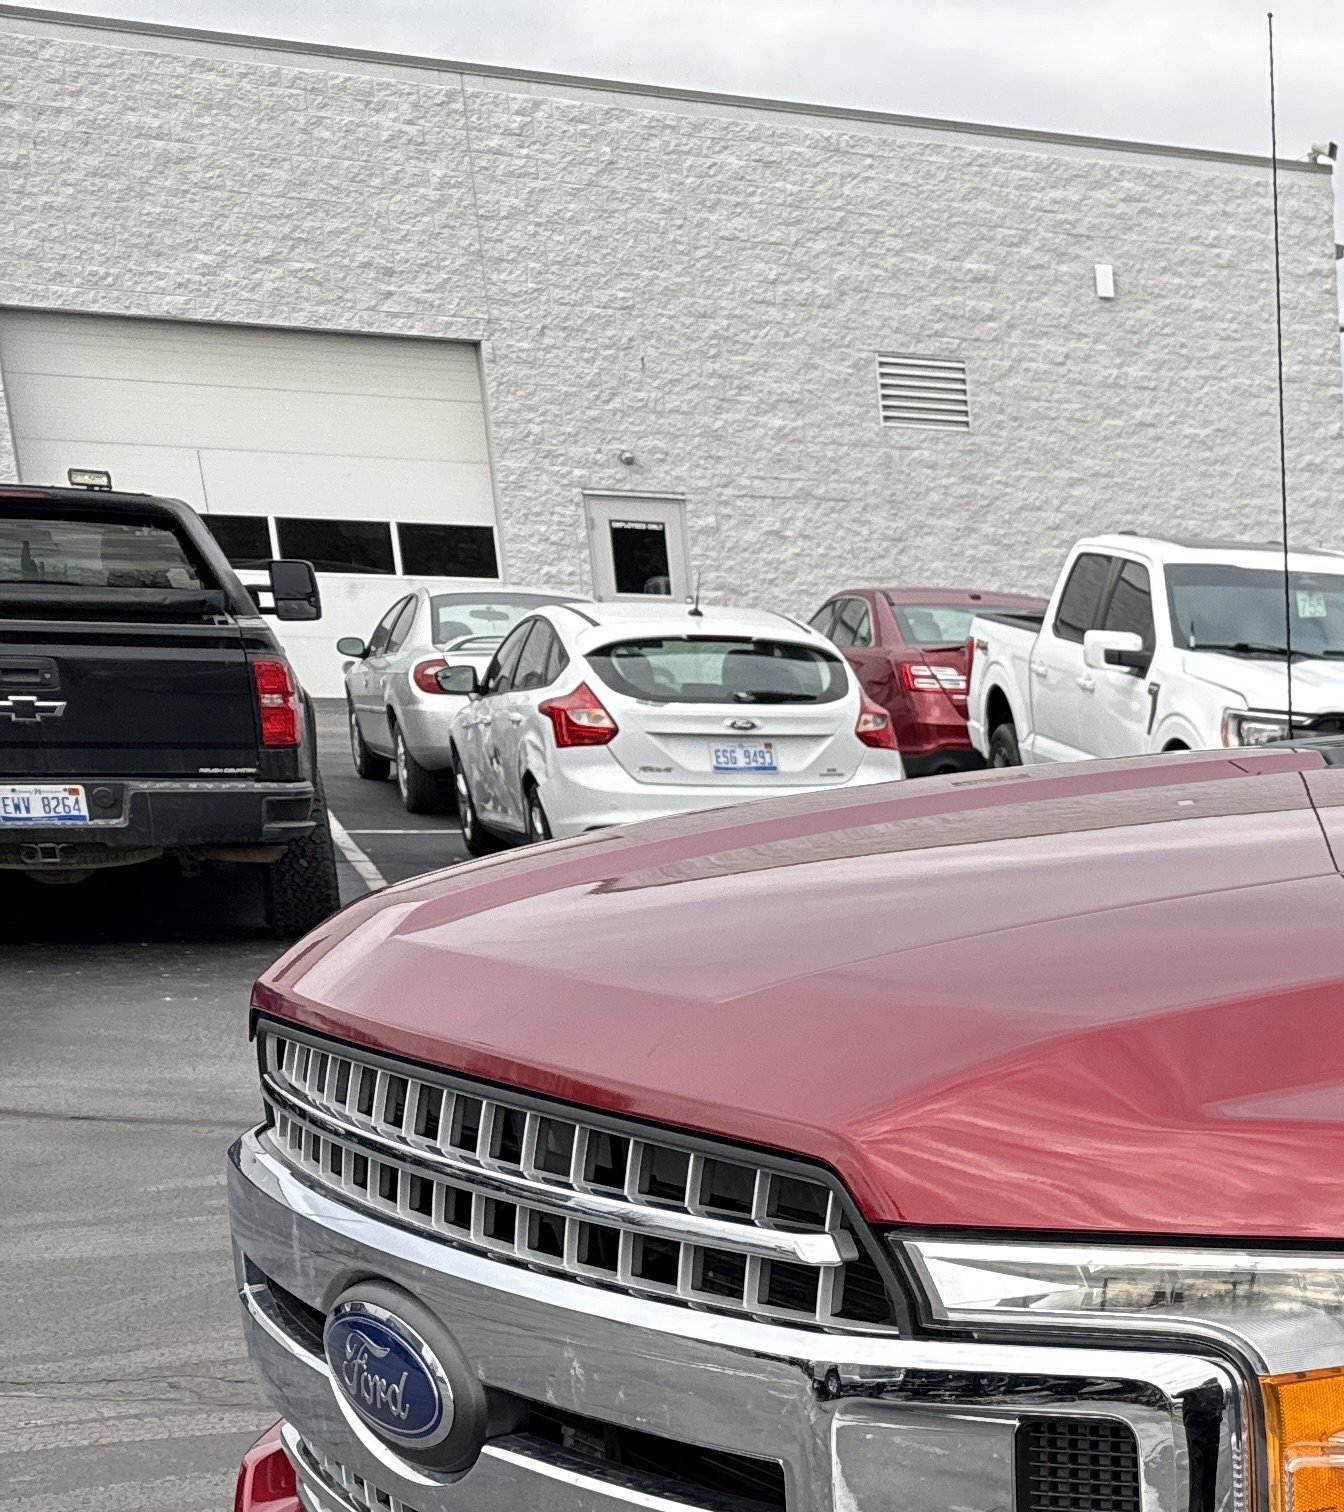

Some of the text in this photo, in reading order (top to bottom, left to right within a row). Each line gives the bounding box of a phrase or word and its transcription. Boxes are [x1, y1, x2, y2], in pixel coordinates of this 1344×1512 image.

[714, 749, 773, 766] ESG 9493
[1, 796, 82, 815] EWV 8264
[342, 1328, 410, 1420] Ford
